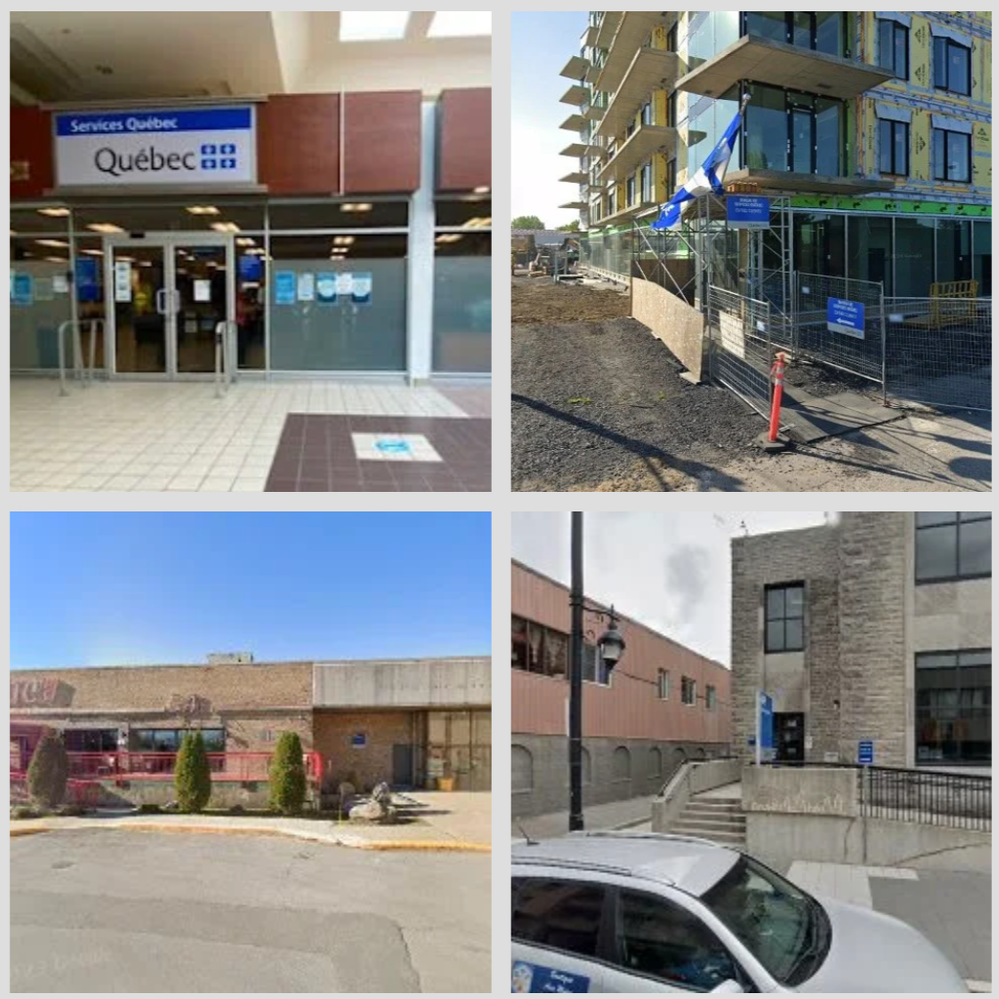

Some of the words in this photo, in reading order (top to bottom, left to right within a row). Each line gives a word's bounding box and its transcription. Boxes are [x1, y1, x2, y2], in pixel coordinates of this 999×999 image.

[70, 119, 124, 133] Services
[125, 117, 178, 132] Québec
[94, 146, 196, 177] Québec
